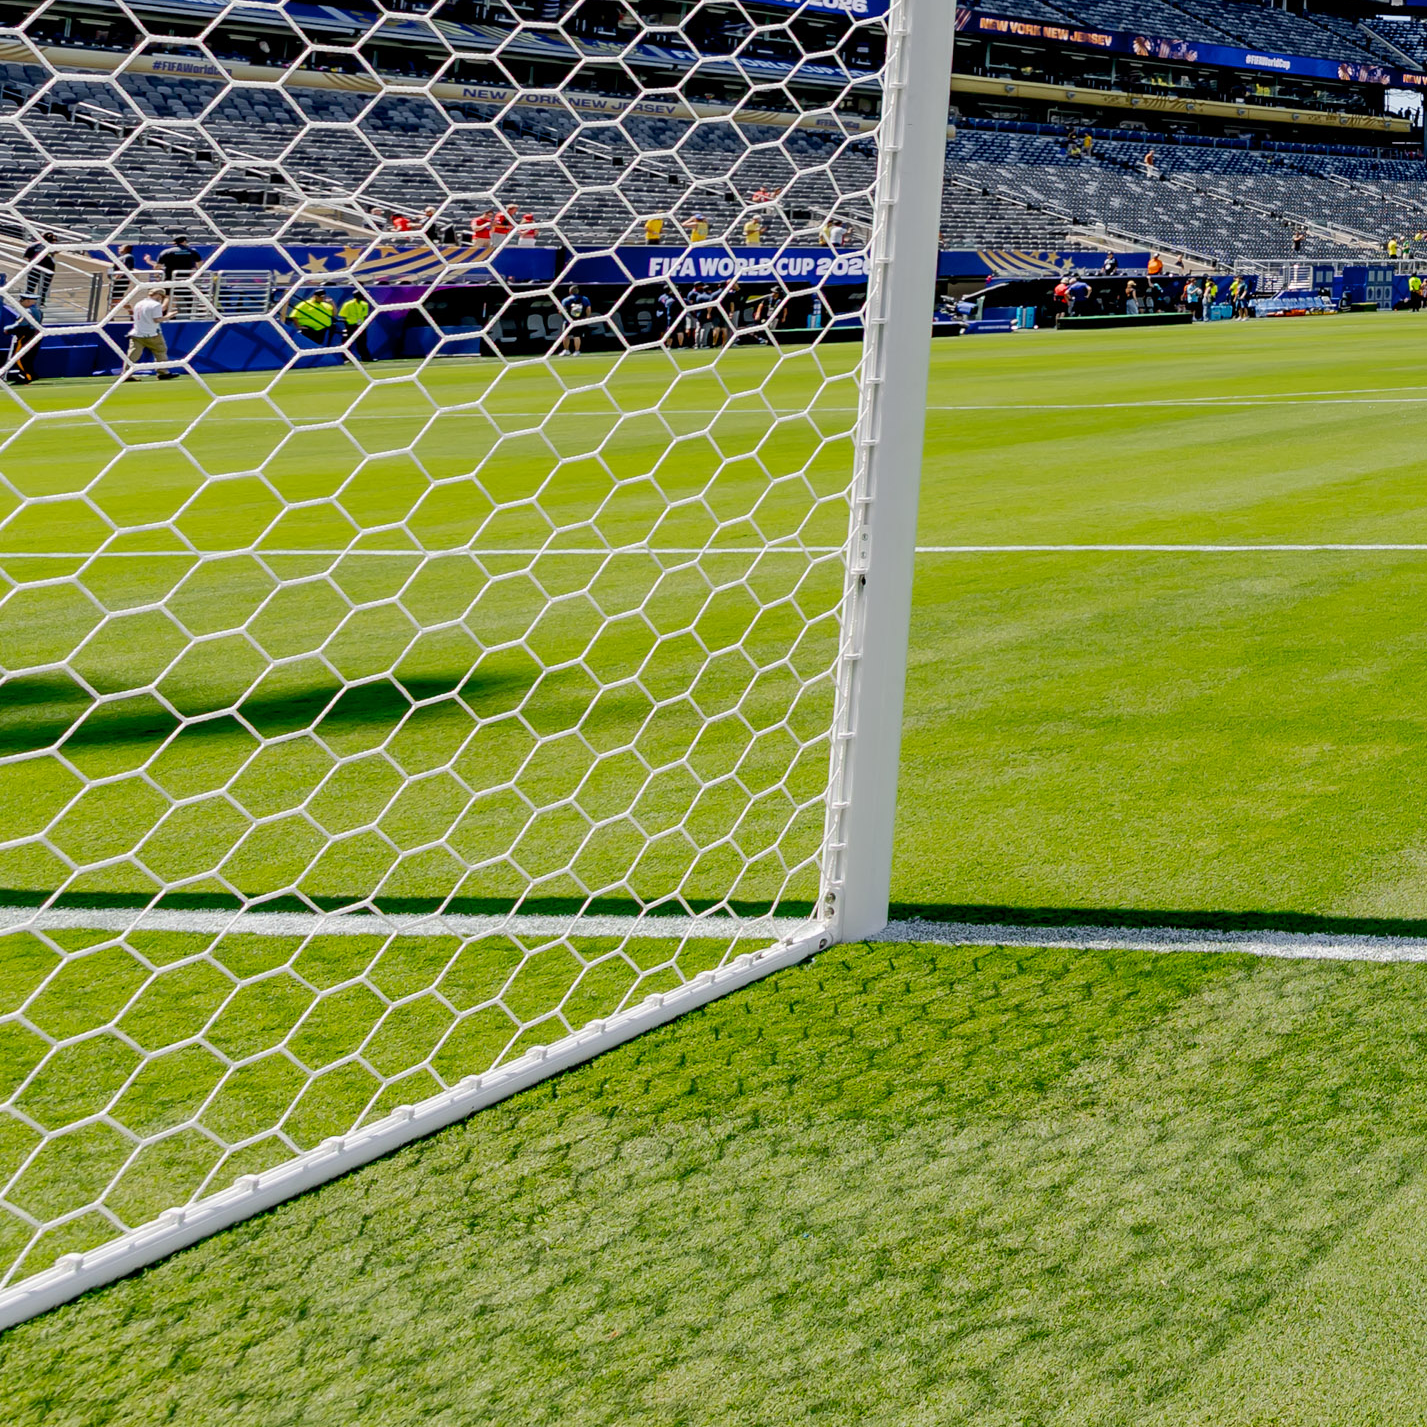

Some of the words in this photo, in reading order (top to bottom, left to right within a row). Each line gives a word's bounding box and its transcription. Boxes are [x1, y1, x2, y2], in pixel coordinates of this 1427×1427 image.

[979, 17, 1008, 32] NEW
[1010, 22, 1041, 36] YORK
[1043, 26, 1069, 41] NEW
[1070, 31, 1112, 47] JERSEY
[462, 88, 507, 100] NEW
[568, 97, 607, 109] NEW
[649, 257, 697, 277] FIFA
[699, 257, 775, 277] WORLD
[776, 257, 815, 277] CUP
